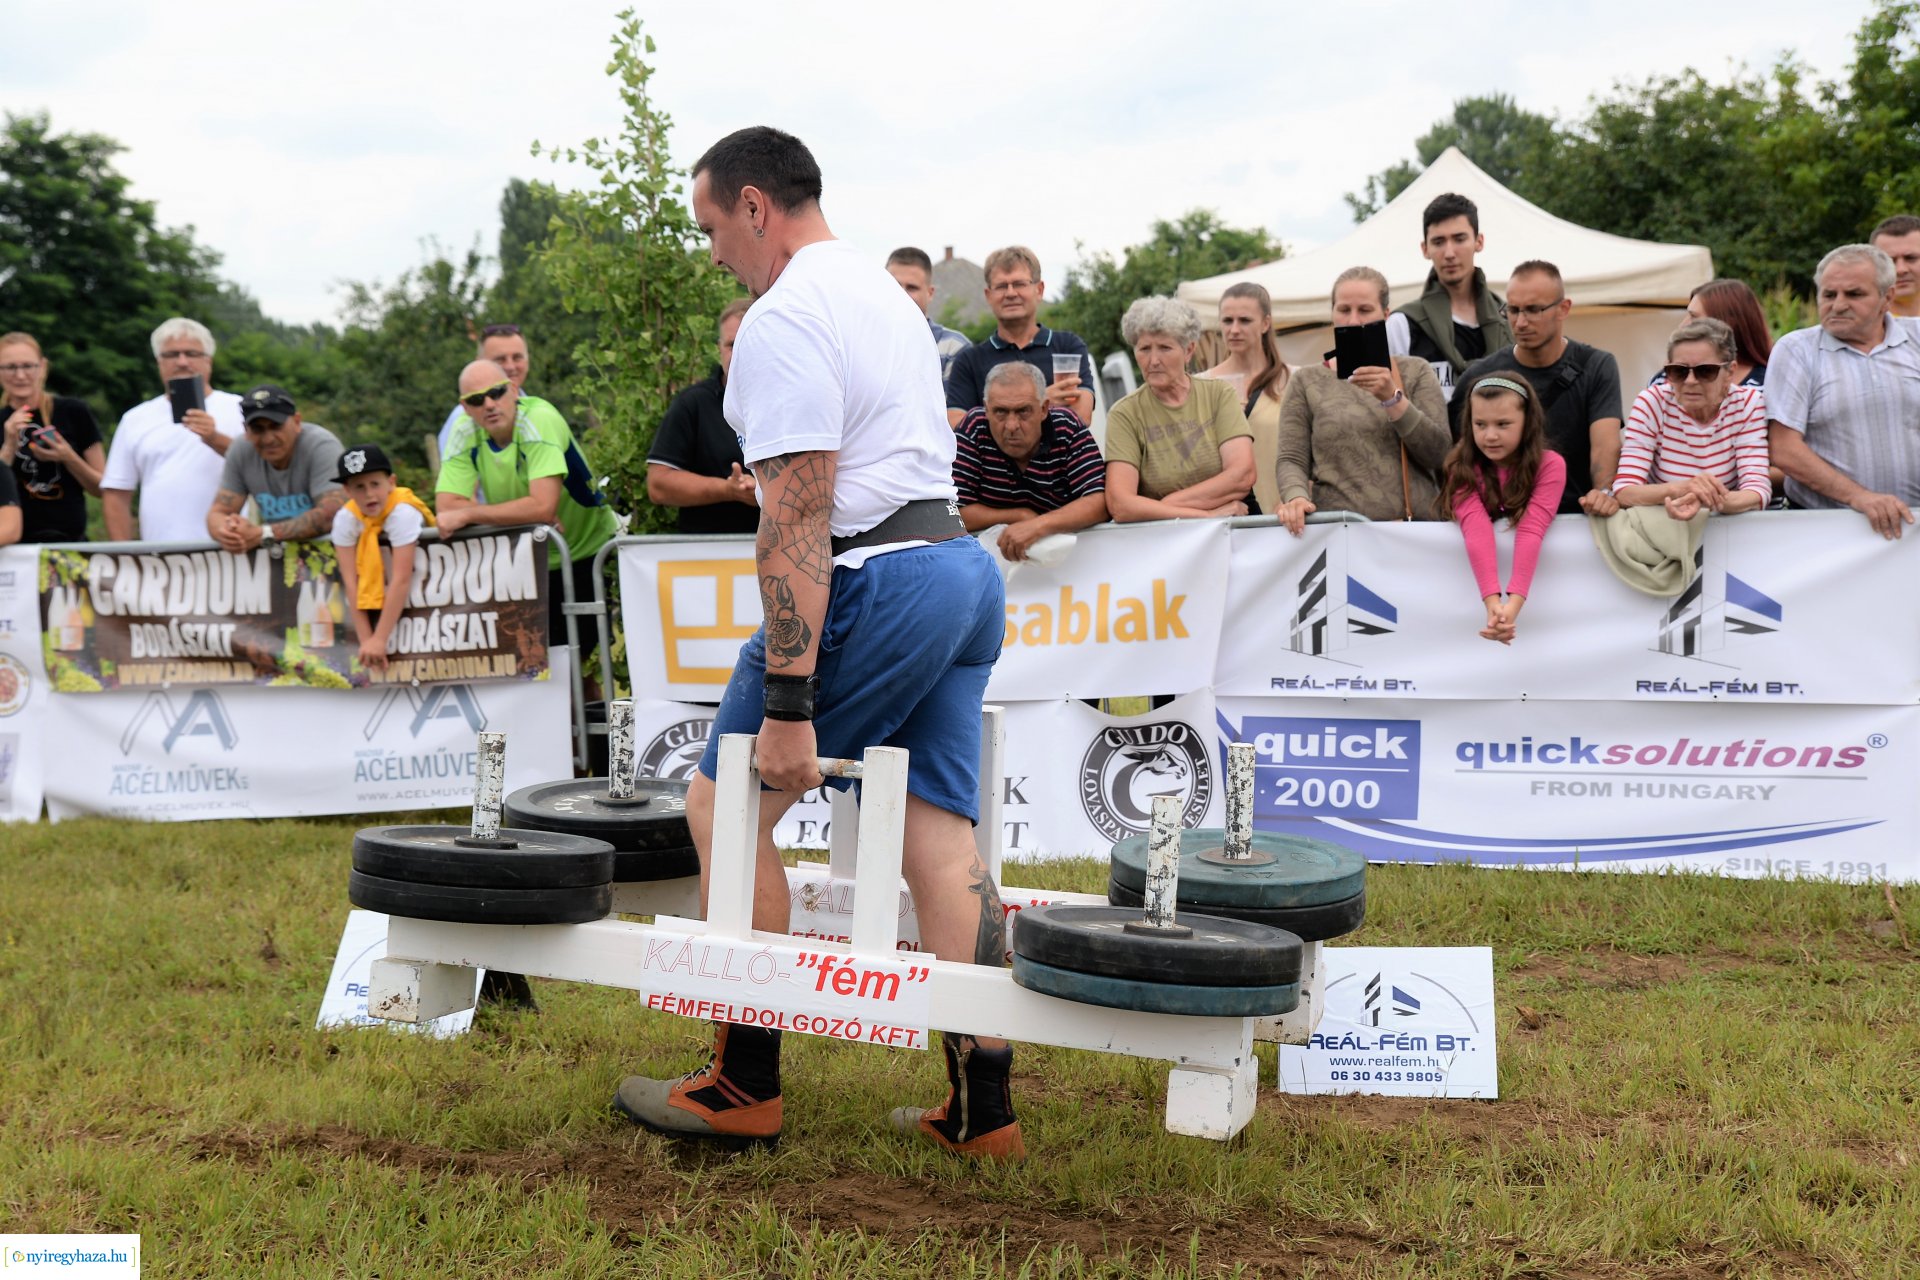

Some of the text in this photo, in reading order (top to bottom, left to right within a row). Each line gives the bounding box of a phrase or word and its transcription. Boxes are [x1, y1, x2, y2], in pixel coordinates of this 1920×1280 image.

[88, 549, 272, 616] CARDIUM
[380, 532, 538, 609] RDIUM
[129, 617, 236, 659] BORÁSZAT
[664, 721, 714, 749] GUI
[1104, 723, 1188, 749] GUIDO
[1254, 727, 1408, 763] quick
[110, 763, 241, 796] ACÉLMŰVEK
[354, 747, 478, 782] ACÉLMŰVE
[356, 786, 476, 801] WWW.ACELMUVE
[1084, 768, 1138, 840] LOVASPA
[1274, 777, 1381, 809] 2000
[1530, 780, 1777, 801] FROM HUNGARY
[1725, 857, 1888, 876] SINCE 1991
[647, 992, 922, 1048] FÉMFELDOLGOZÓ KFT.
[1331, 1071, 1443, 1082] 06 30 433 9809
